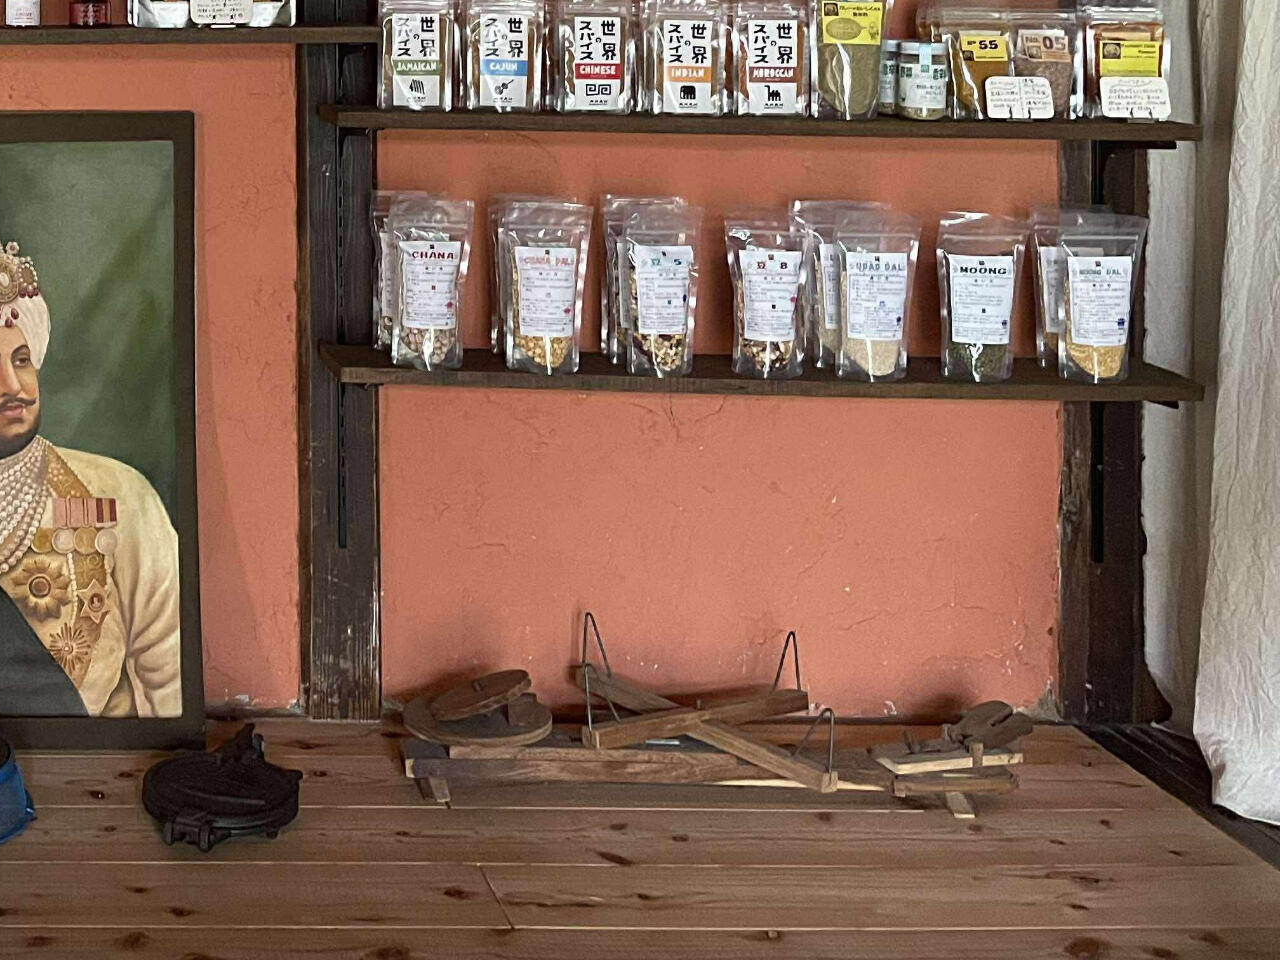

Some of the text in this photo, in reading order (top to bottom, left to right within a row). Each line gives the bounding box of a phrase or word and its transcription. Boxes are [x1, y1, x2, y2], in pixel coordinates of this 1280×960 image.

[397, 16, 412, 57] スパイス
[484, 17, 501, 58] スパイス
[579, 20, 594, 61] スパイス
[668, 23, 683, 64] スパイス
[753, 24, 769, 64] スパイス
[396, 61, 437, 72] JAMAICAN
[489, 62, 518, 72] CAJUN
[579, 65, 616, 75] CHINESE
[671, 68, 705, 78] INDIAN
[752, 68, 794, 78] MOROCCAN
[411, 250, 454, 259] CHANA
[959, 266, 1007, 275] MOONG
